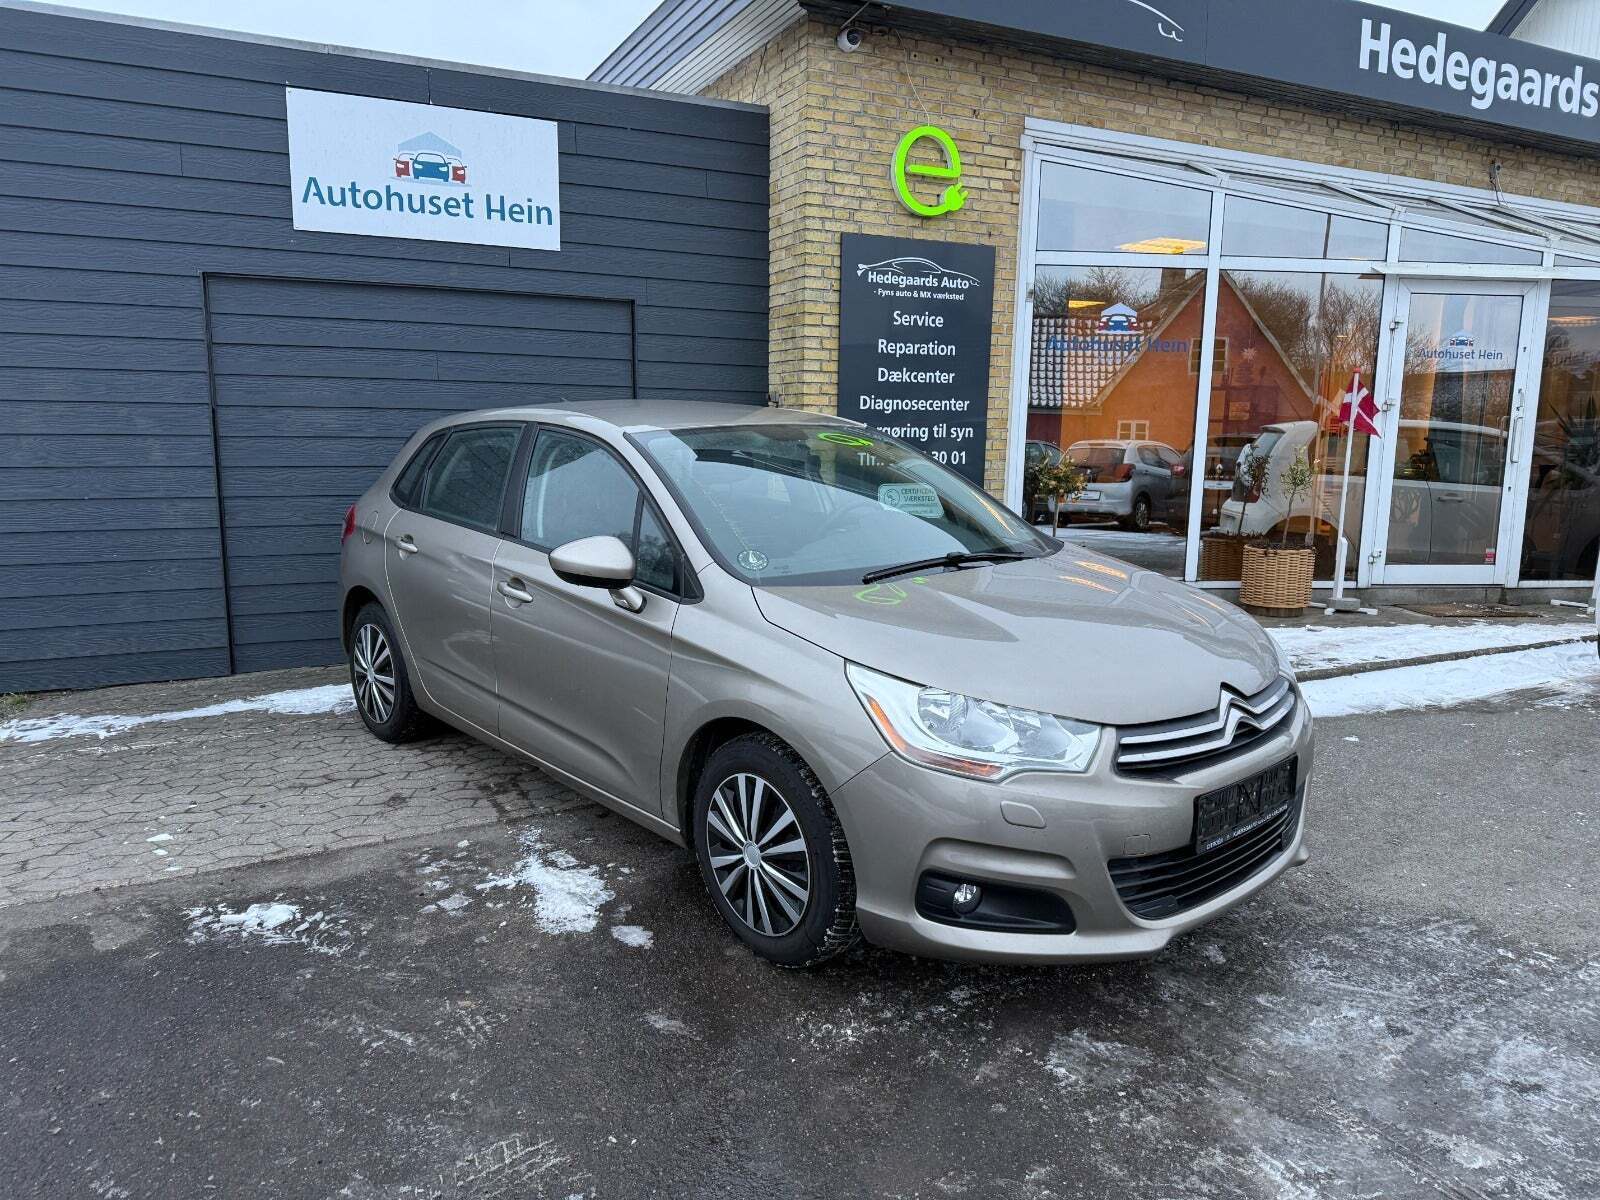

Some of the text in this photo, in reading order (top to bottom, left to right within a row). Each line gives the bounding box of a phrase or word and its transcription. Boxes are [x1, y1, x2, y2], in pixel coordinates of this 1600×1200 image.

[1359, 18, 1599, 118] Hedegaards
[302, 176, 554, 226] Autohuset Hein
[867, 271, 970, 289] Hedegaards Auto
[877, 288, 895, 297] Fyns
[912, 290, 919, 298] &
[932, 292, 965, 301] værksted
[893, 310, 944, 328] Service
[877, 338, 956, 357] Reparation
[1418, 347, 1503, 360] Autohuset Hein
[877, 367, 955, 384] Dækcenter
[859, 395, 970, 414] Diagnosecenter
[932, 423, 947, 438] til
[950, 426, 974, 442] syn
[950, 450, 967, 465] 01
